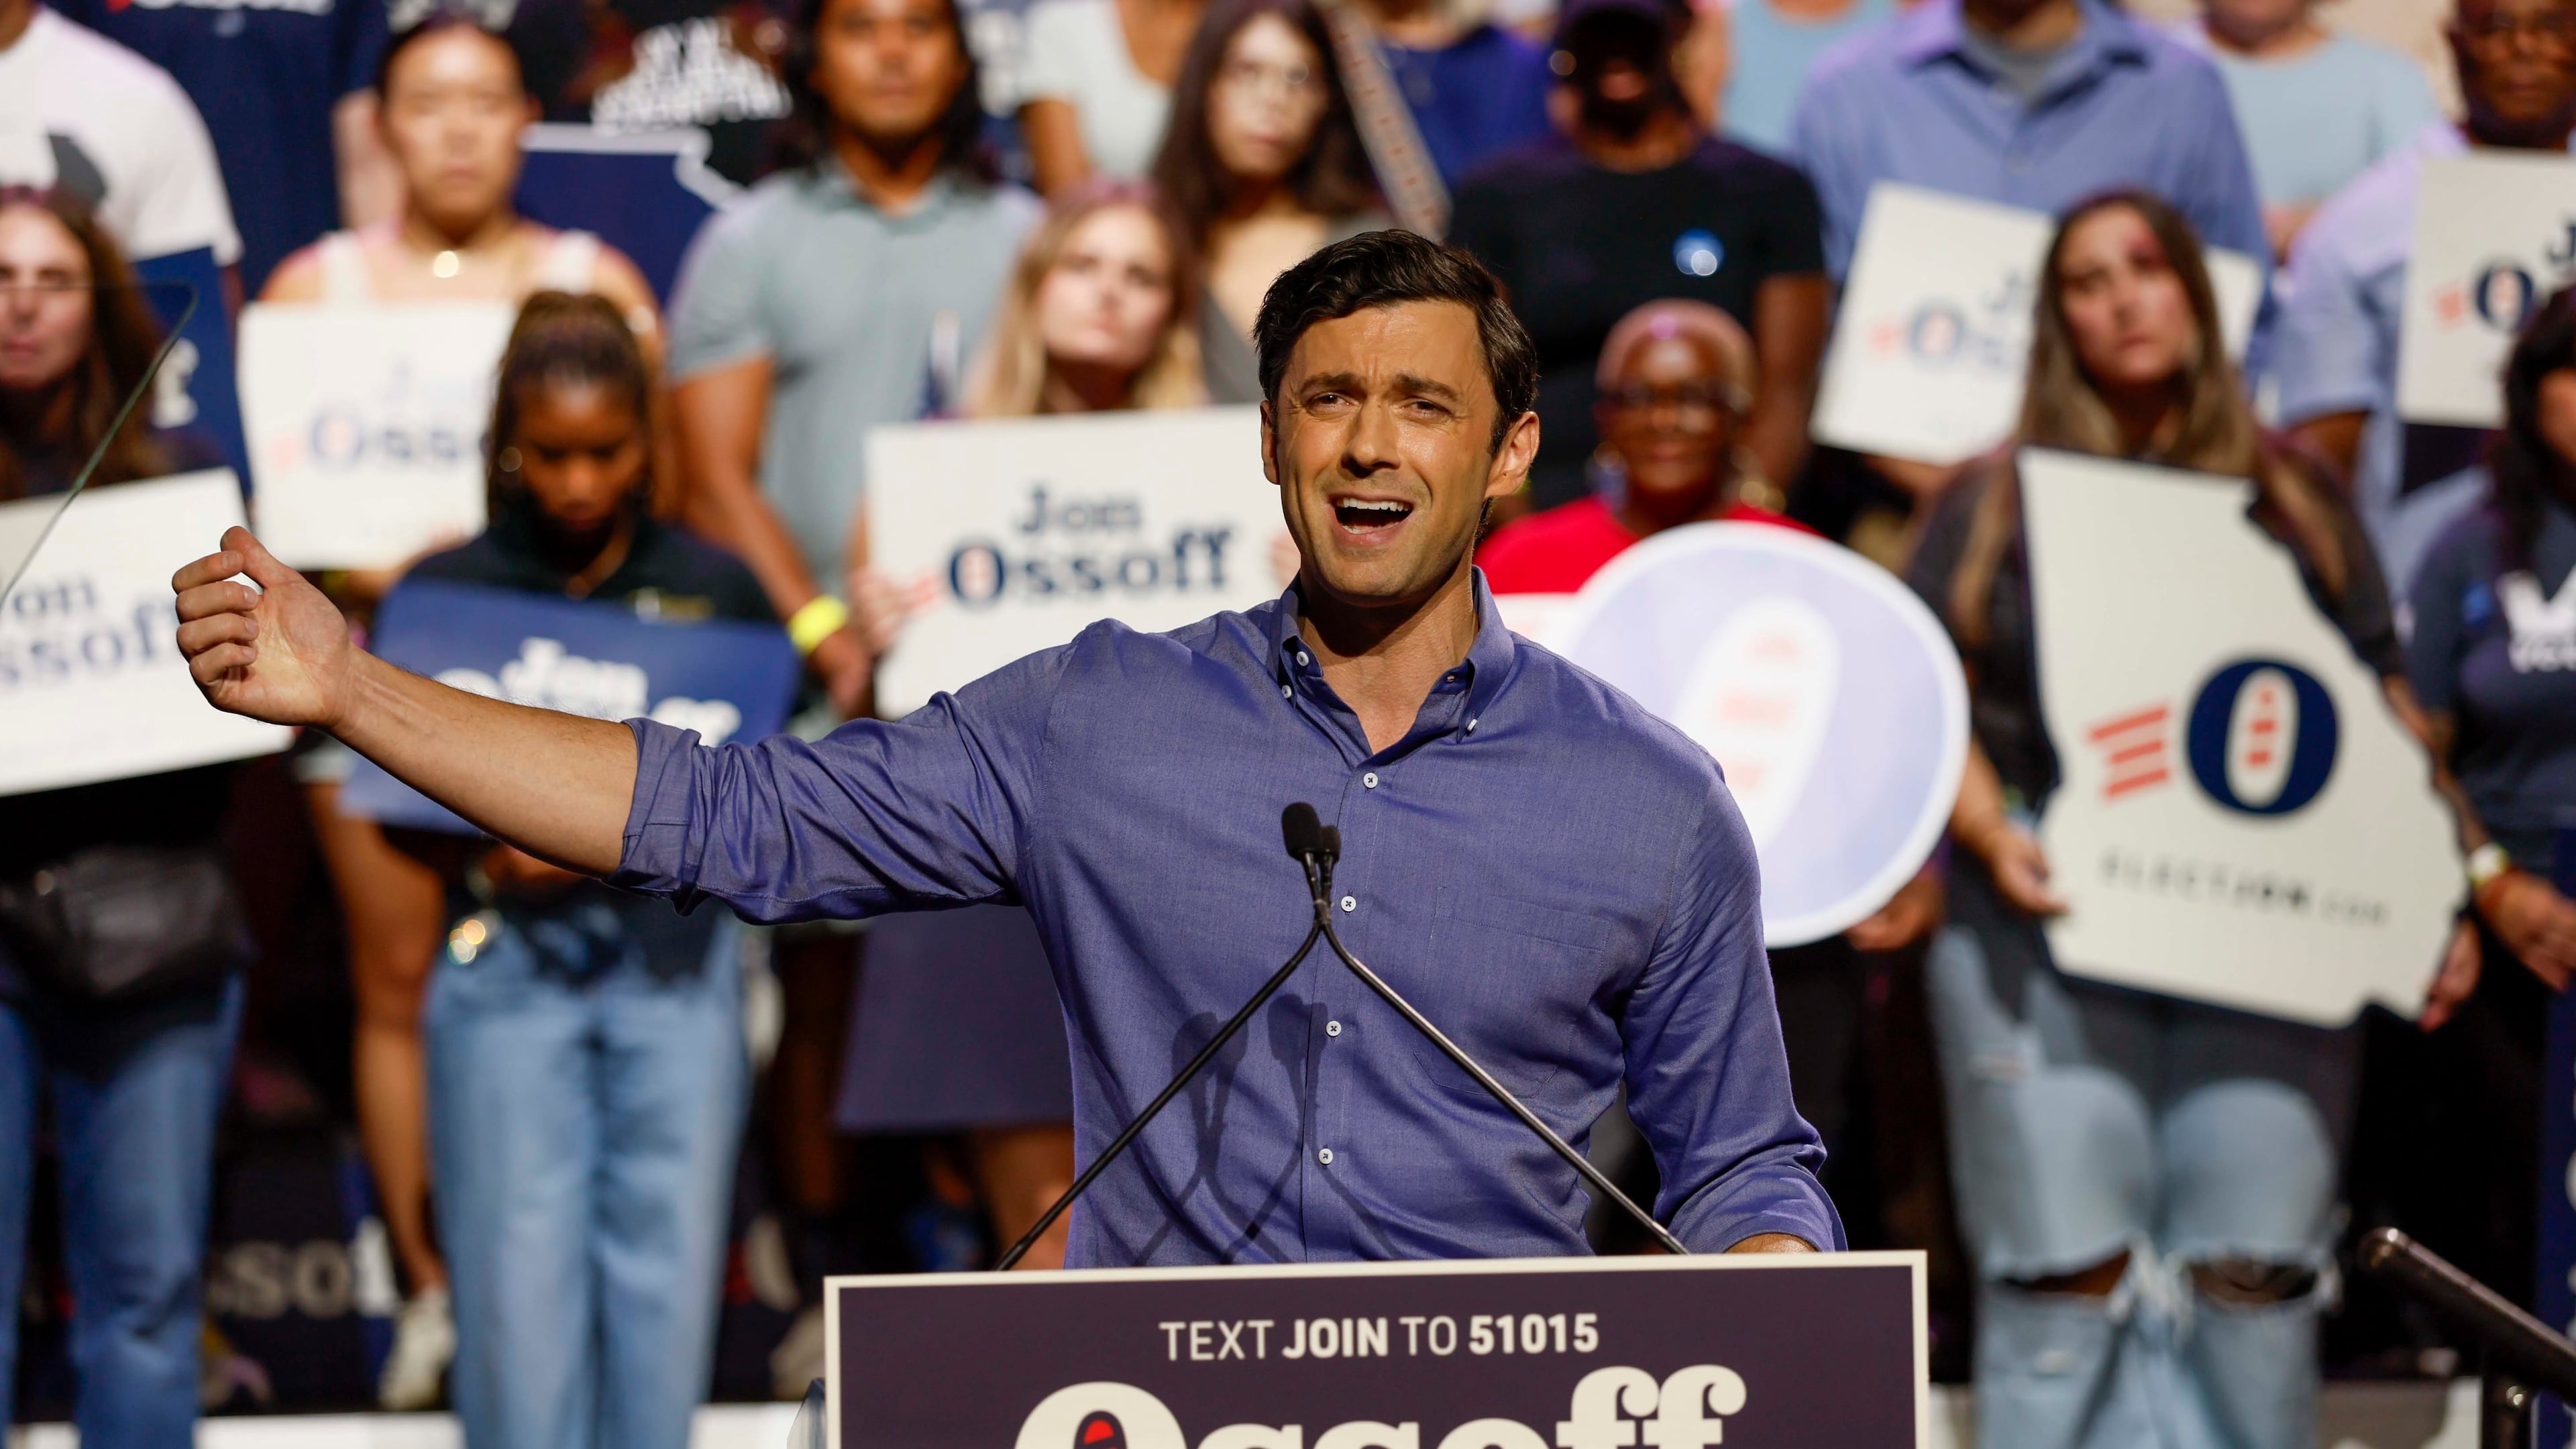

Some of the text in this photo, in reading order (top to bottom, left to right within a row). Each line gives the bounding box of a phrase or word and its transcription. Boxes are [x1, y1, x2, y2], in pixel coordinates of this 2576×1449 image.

[1014, 484, 1142, 534] Jon
[947, 525, 1233, 606] Ossoff
[9, 574, 99, 620] on
[1159, 1313, 1599, 1361] TEXT JOIN TO 51015
